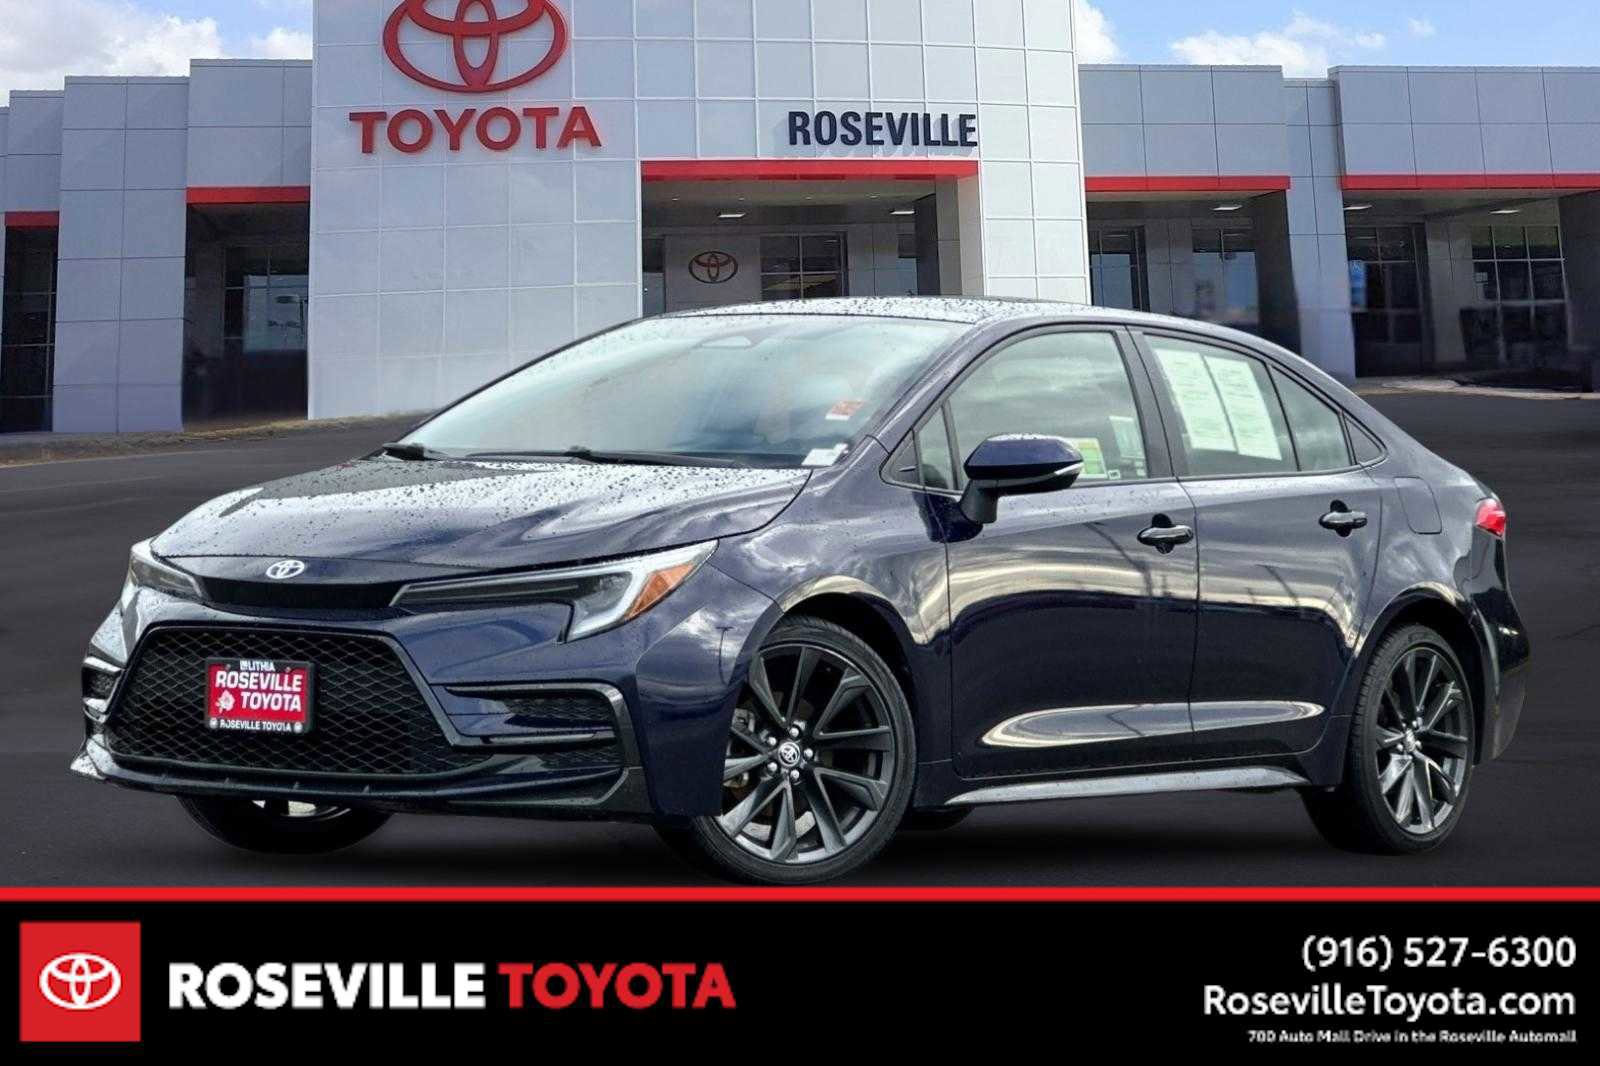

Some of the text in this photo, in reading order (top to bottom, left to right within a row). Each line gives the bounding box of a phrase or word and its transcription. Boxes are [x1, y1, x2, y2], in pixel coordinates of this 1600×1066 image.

[349, 106, 602, 154] TOYOTA
[789, 111, 978, 147] ROSEVILLE
[215, 671, 302, 691] ROSEVILLE
[241, 691, 302, 712] TOYOTA
